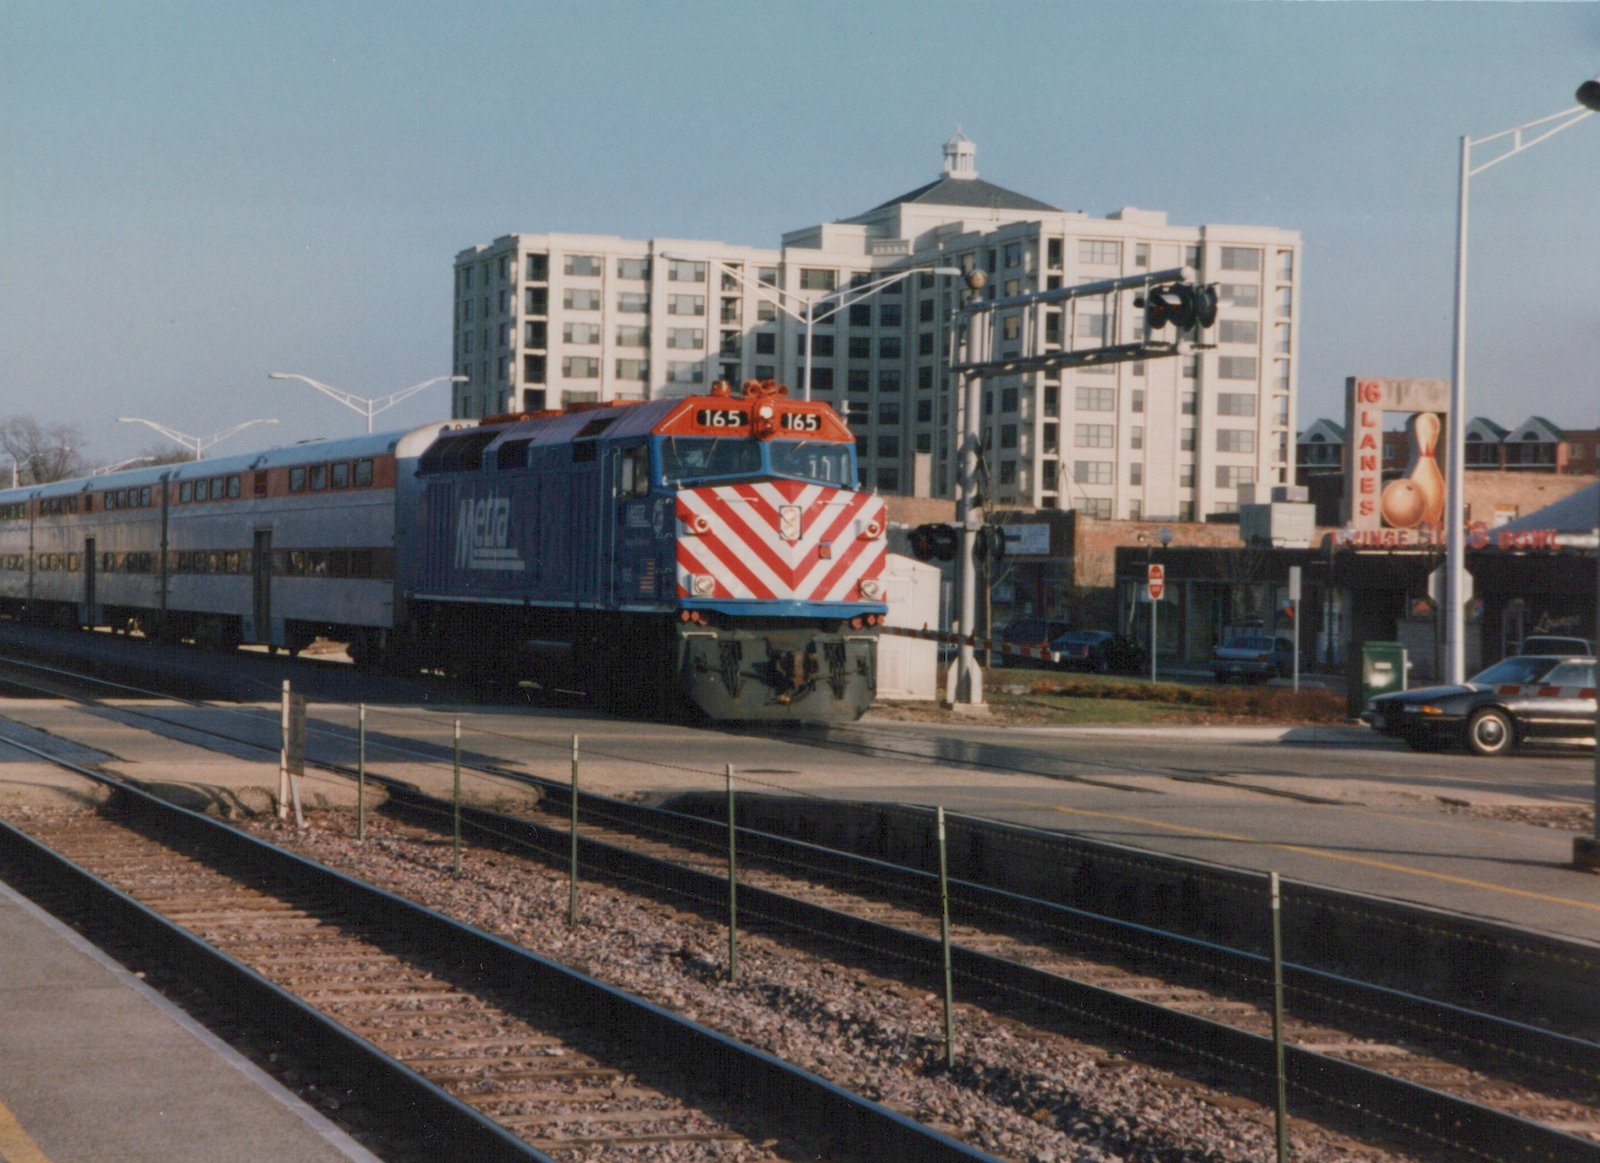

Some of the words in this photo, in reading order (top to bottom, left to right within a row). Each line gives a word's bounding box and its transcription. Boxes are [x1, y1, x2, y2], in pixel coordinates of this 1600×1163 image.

[1357, 381, 1381, 404] 16
[704, 409, 741, 428] 165
[786, 412, 818, 431] 165
[1359, 411, 1377, 516] LANES
[454, 490, 511, 570] Metra
[1497, 529, 1562, 551] BOWL
